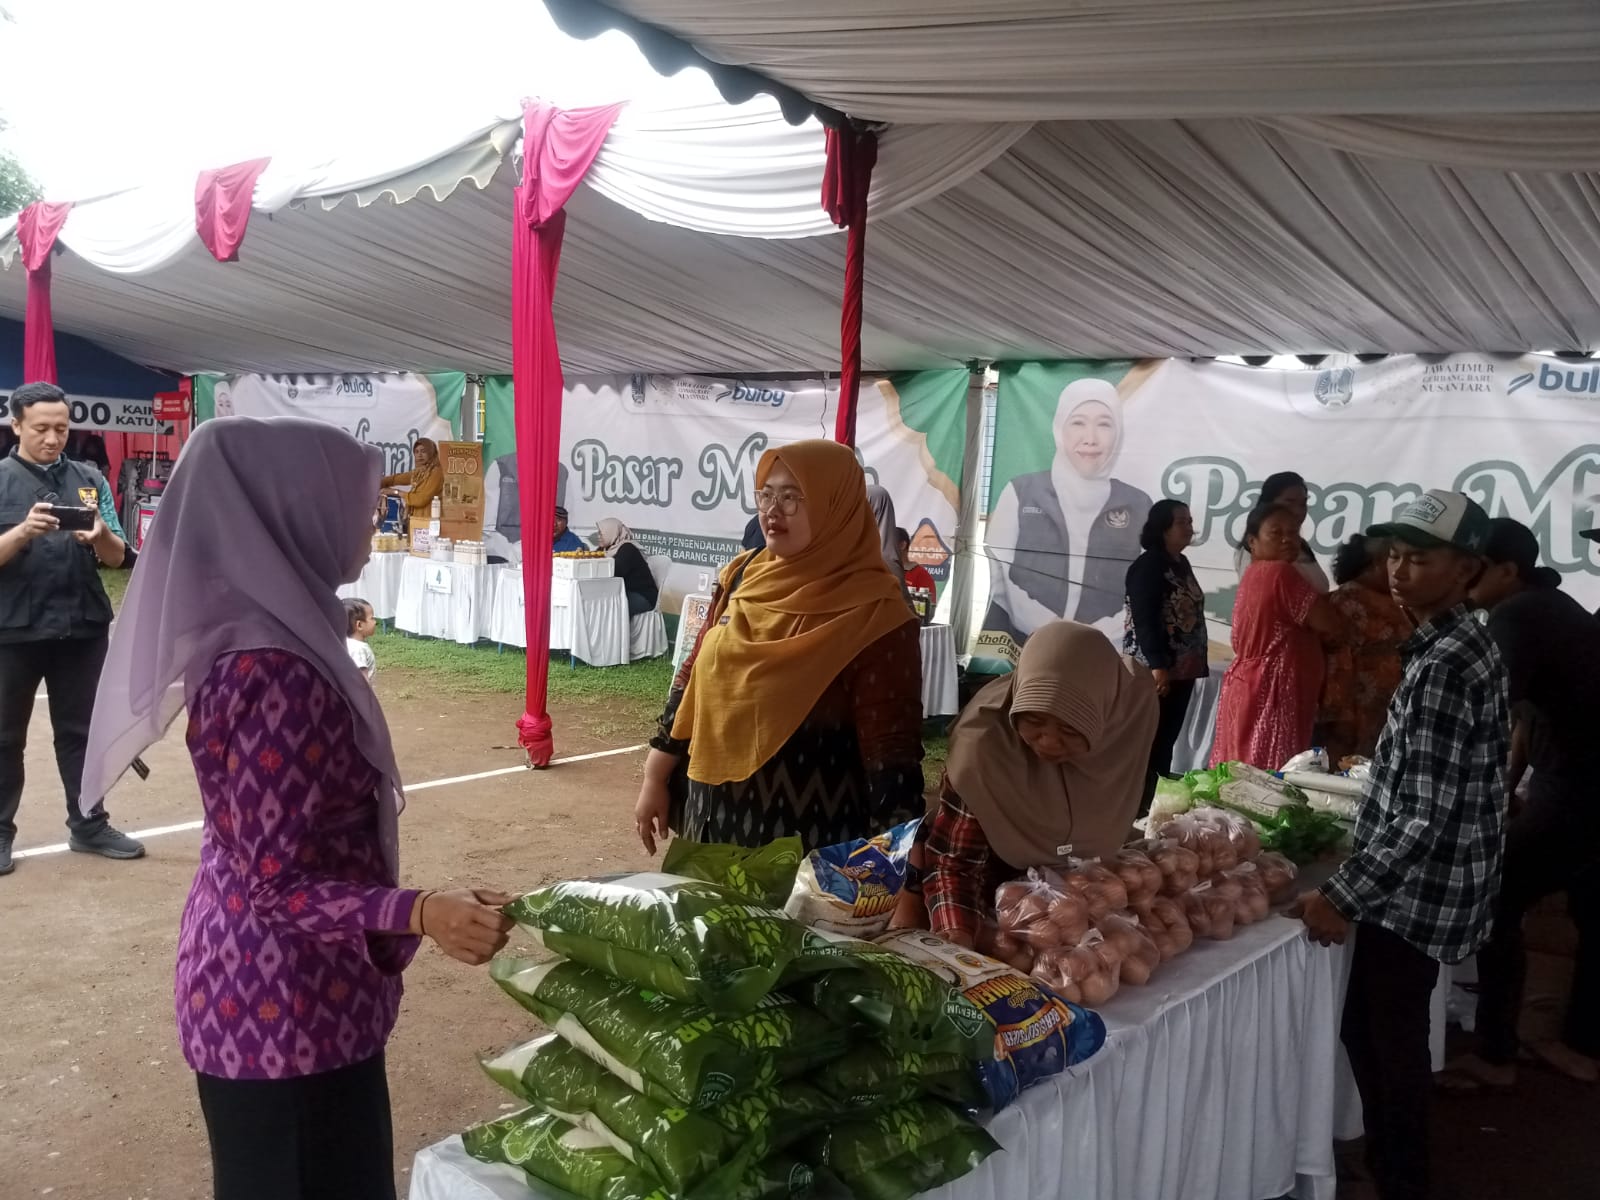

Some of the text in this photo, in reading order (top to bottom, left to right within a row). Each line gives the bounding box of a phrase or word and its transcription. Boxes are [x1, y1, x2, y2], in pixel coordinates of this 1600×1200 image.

[1538, 362, 1600, 394] bul
[571, 439, 683, 507] Pasar
[668, 536, 734, 552] PENGENDALIAN
[673, 550, 707, 563] BARANG
